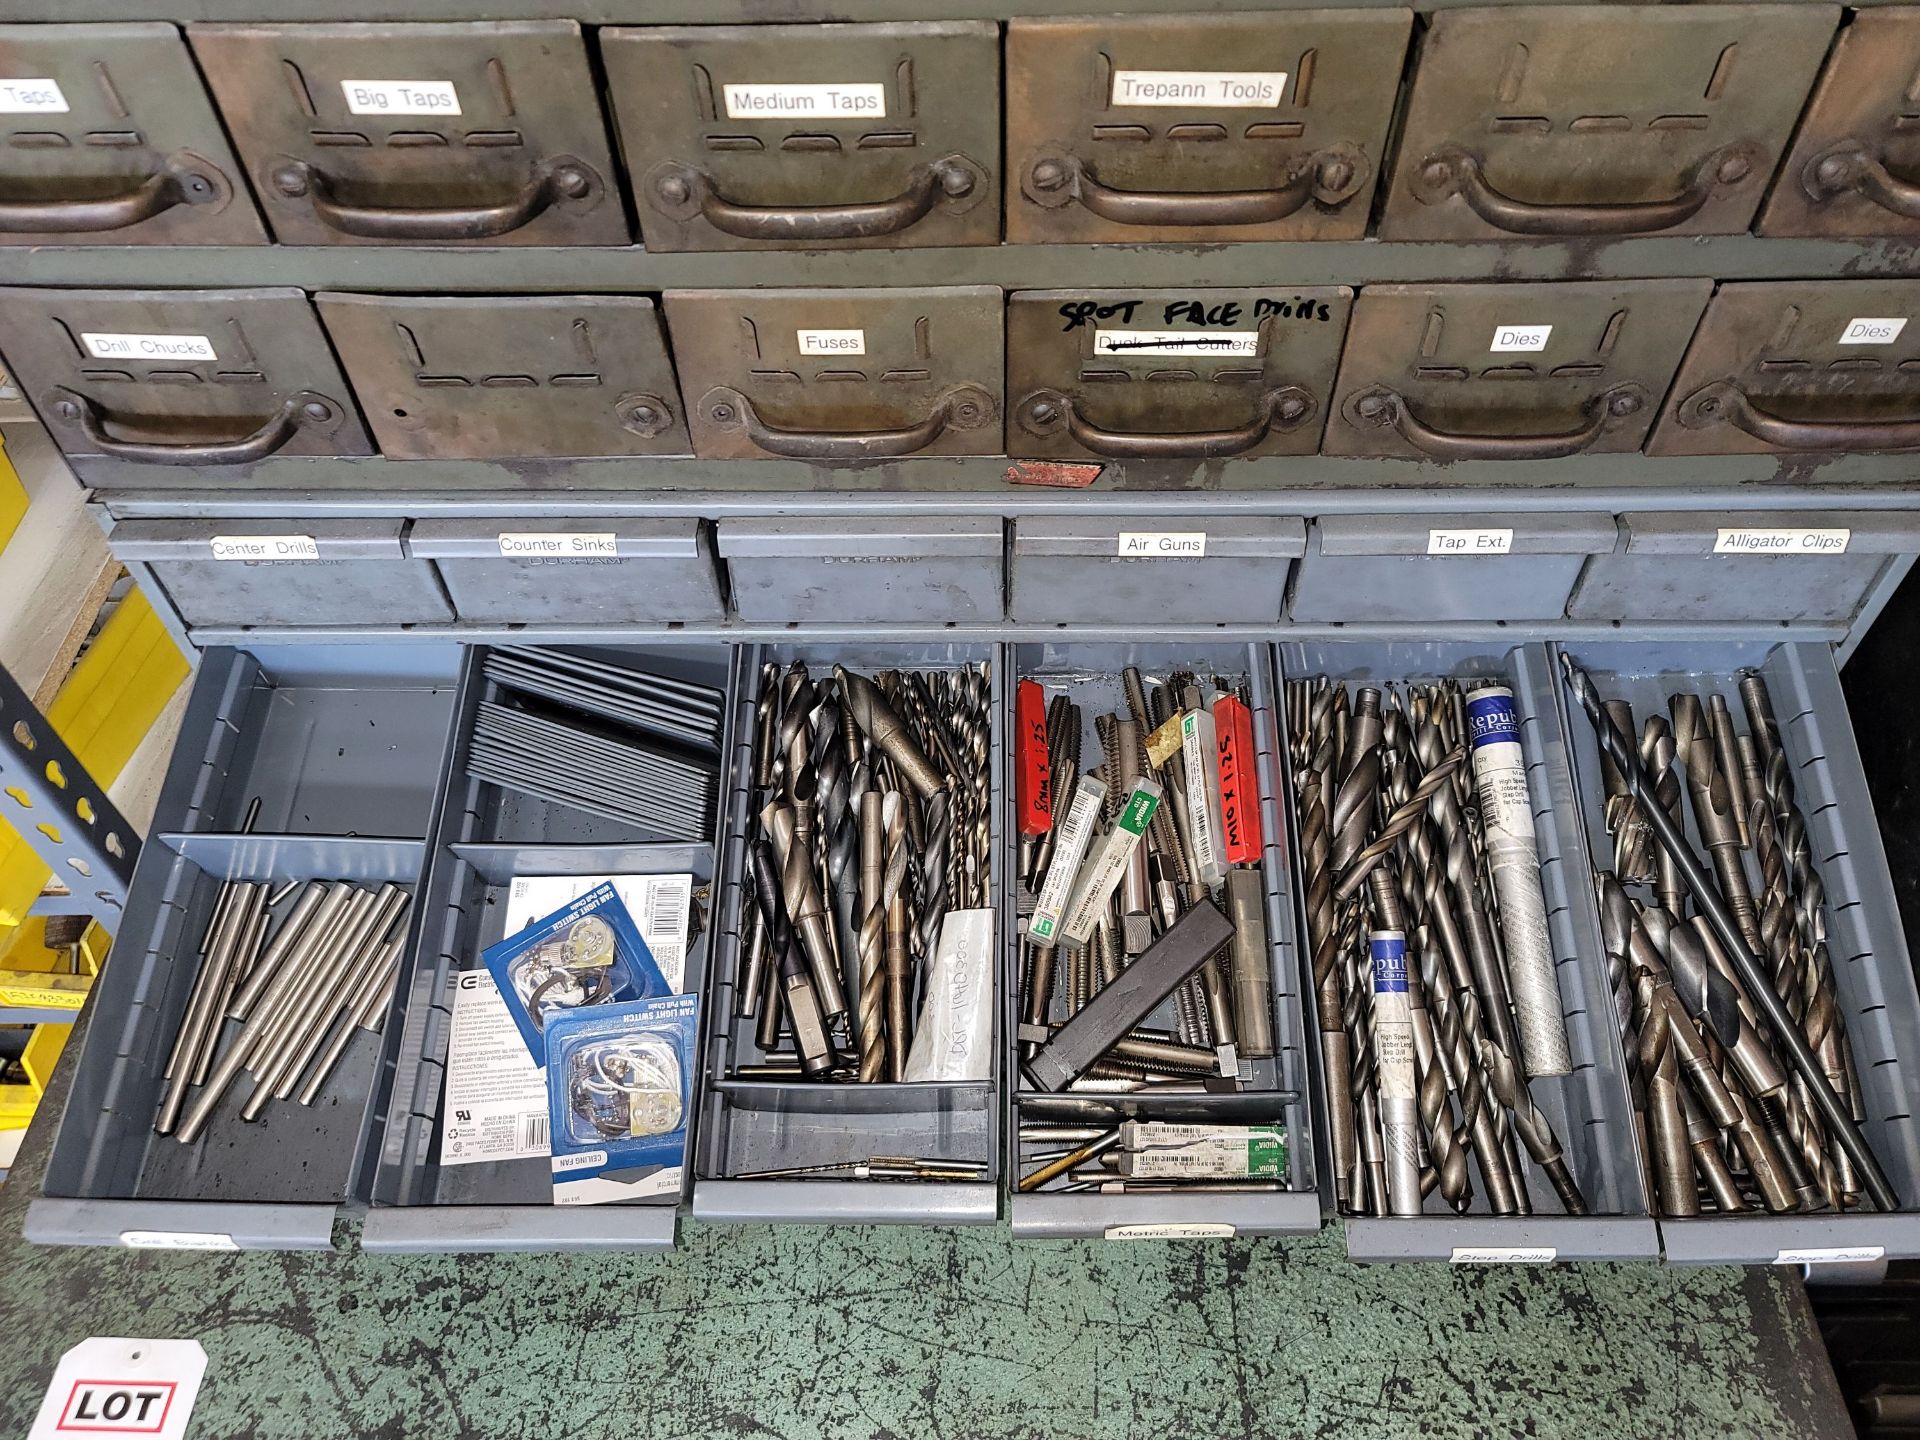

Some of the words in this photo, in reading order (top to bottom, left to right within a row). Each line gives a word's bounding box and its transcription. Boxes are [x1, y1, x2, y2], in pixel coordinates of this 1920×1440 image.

[3, 87, 57, 105] Taps
[1122, 79, 1206, 99] Trepann
[1220, 80, 1273, 98] Tools
[353, 88, 389, 108] Big
[397, 88, 452, 108] Taps
[734, 93, 814, 109] Medium
[827, 92, 878, 111] Taps
[1163, 301, 1242, 326] FACE
[1500, 331, 1540, 345] Dies
[1850, 324, 1891, 338] Dies
[95, 339, 132, 352] Drill
[140, 340, 208, 355] Chucks
[806, 335, 859, 349] Fuses
[212, 542, 266, 555] Center
[275, 541, 317, 554] Drills
[500, 537, 562, 551] Counter
[572, 537, 616, 551] Sinks
[1127, 538, 1149, 551] Air
[1159, 537, 1200, 551] Guns
[1435, 535, 1466, 550] Tap
[1476, 535, 1506, 548] Ext.
[1723, 534, 1793, 549] Alligator
[1802, 534, 1844, 550] Clips
[1220, 735, 1233, 782] 1.25
[1226, 806, 1240, 846] M10
[600, 891, 614, 904] FAN
[580, 899, 601, 916] LIGHT
[552, 910, 580, 931] SWITCH
[623, 1012, 654, 1023] SWITCH
[656, 1008, 678, 1019] LIGHT
[680, 1006, 694, 1016] FAN
[560, 1158, 574, 1167] FAN
[575, 1153, 602, 1164] CEILING
[1118, 1229, 1168, 1238] Metric
[1179, 1229, 1222, 1237] Taps
[1509, 1253, 1552, 1261] Drills
[74, 1389, 163, 1421] LOT
